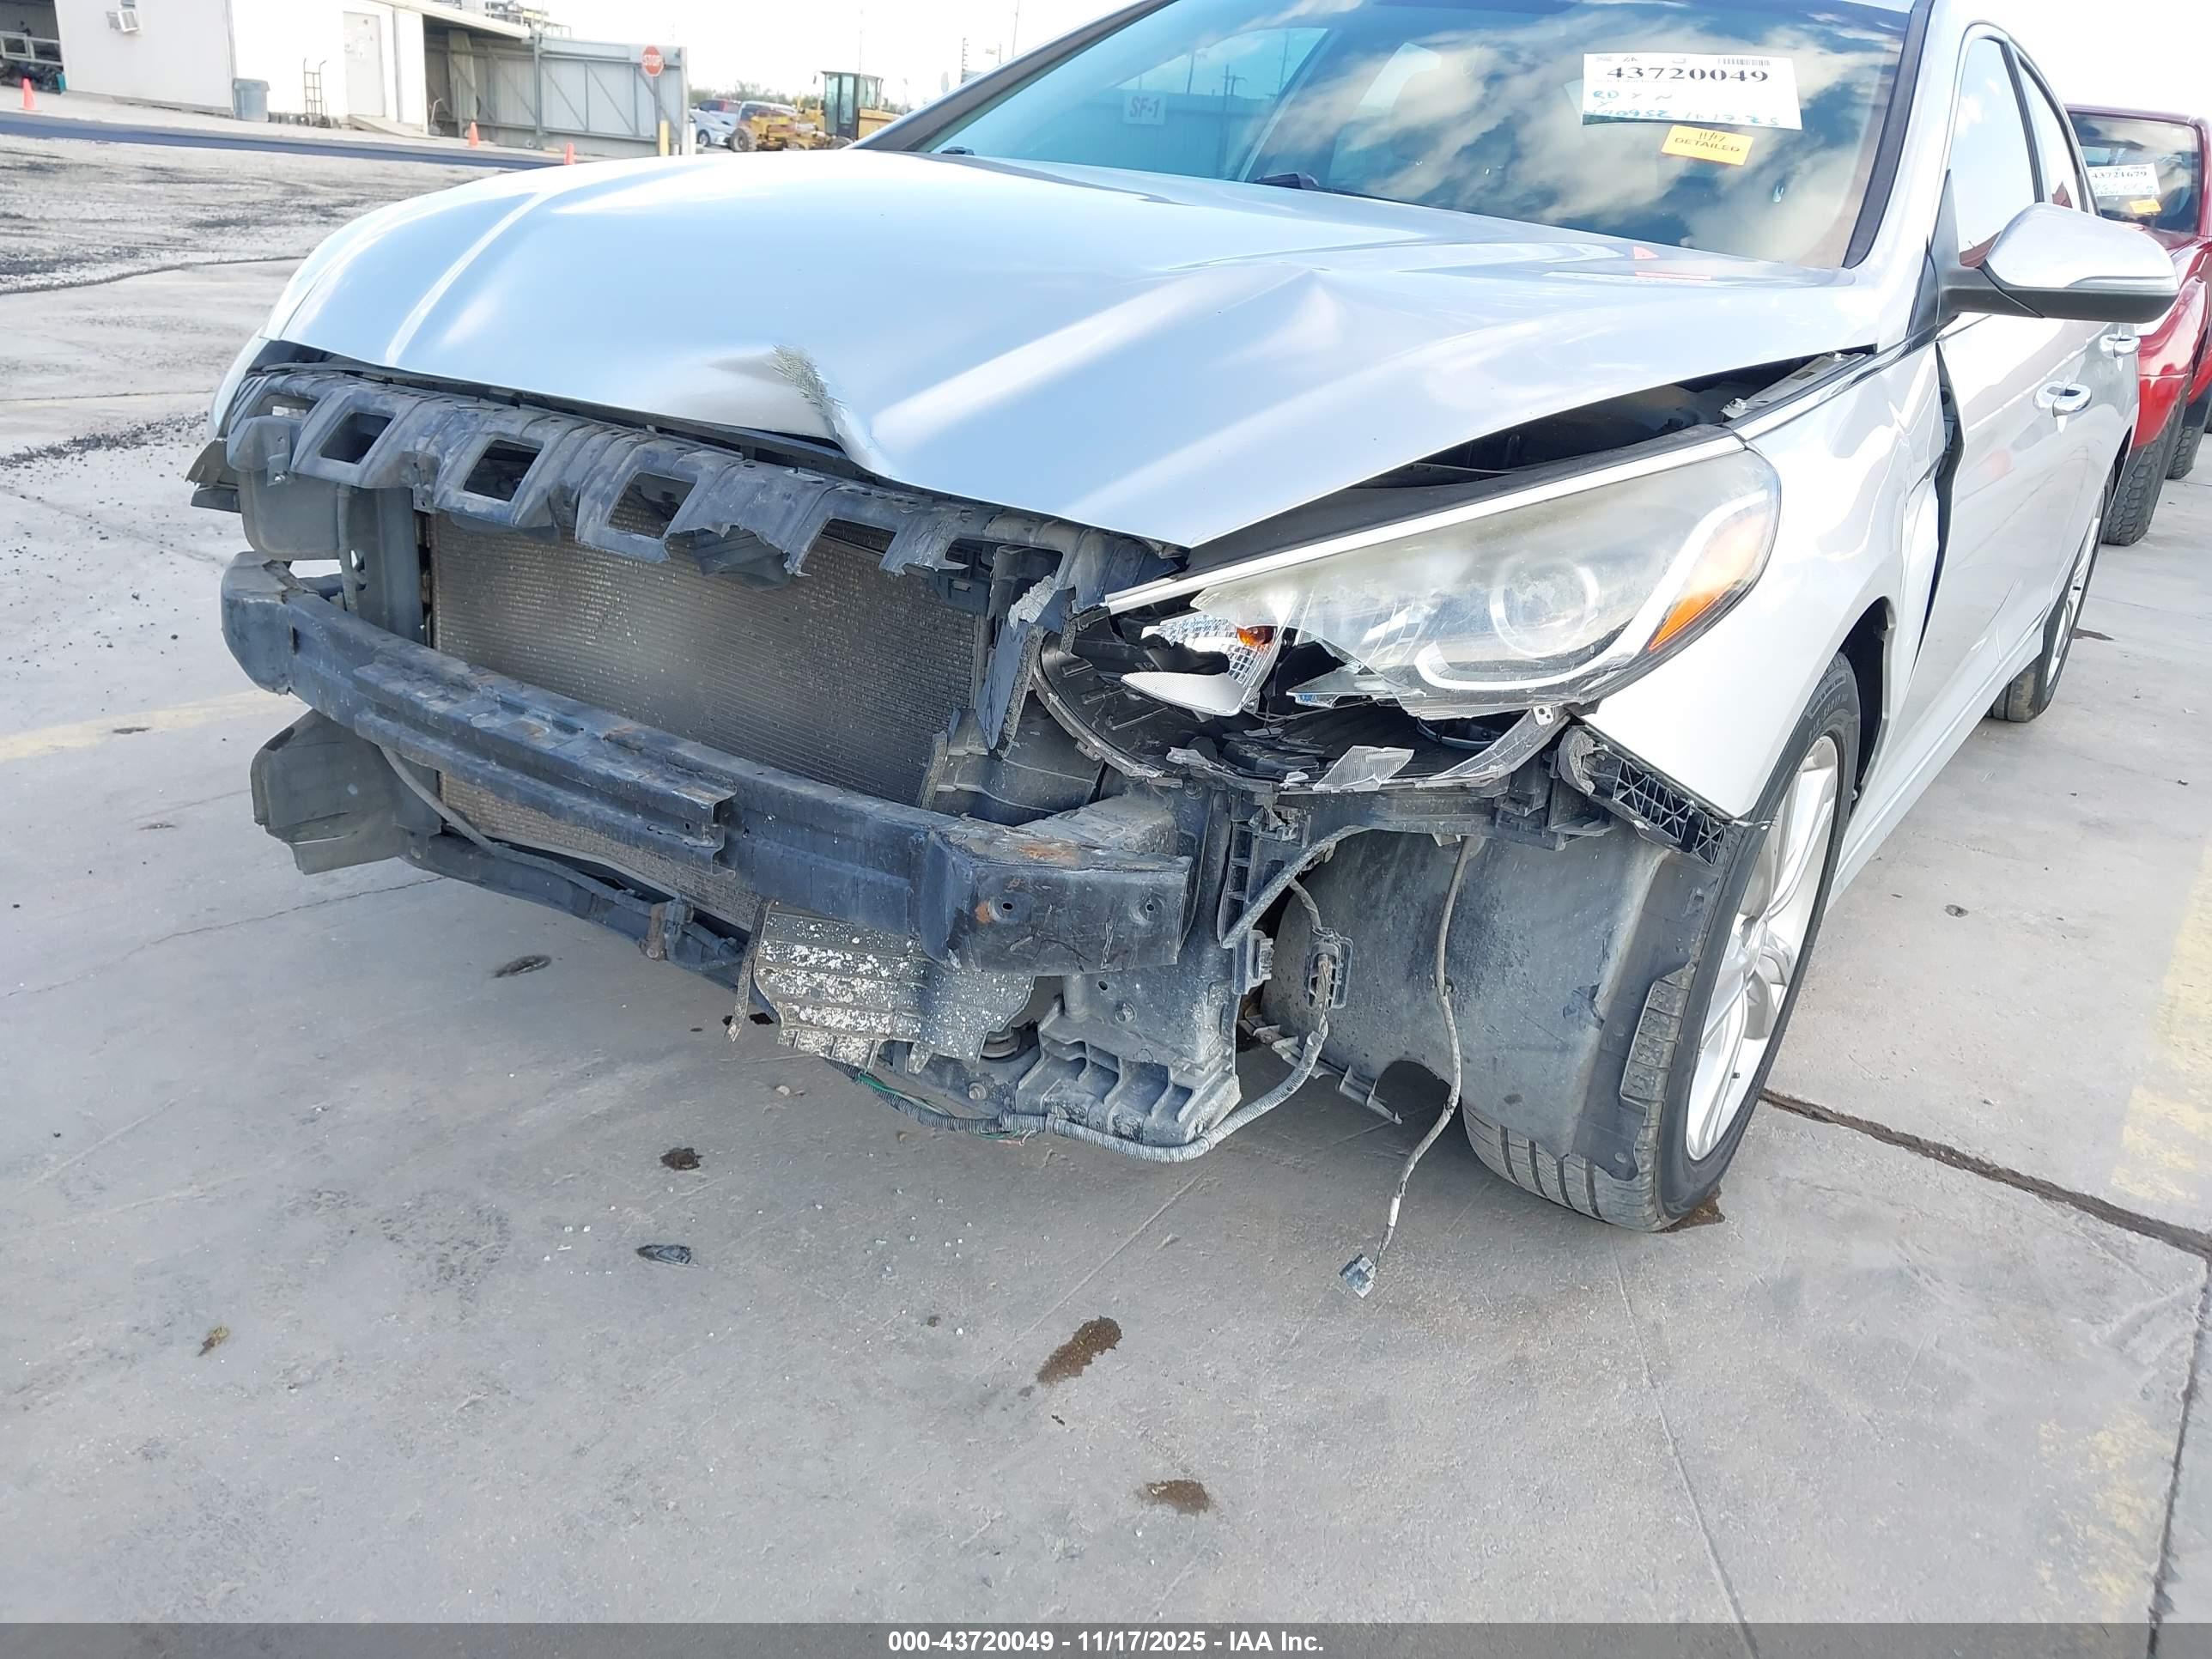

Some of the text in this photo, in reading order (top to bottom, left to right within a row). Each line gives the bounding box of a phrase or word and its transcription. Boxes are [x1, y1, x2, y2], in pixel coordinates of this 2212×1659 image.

[644, 54, 663, 67] STOP
[1607, 66, 1769, 83] 43720049
[1674, 137, 1741, 153] DETAILED
